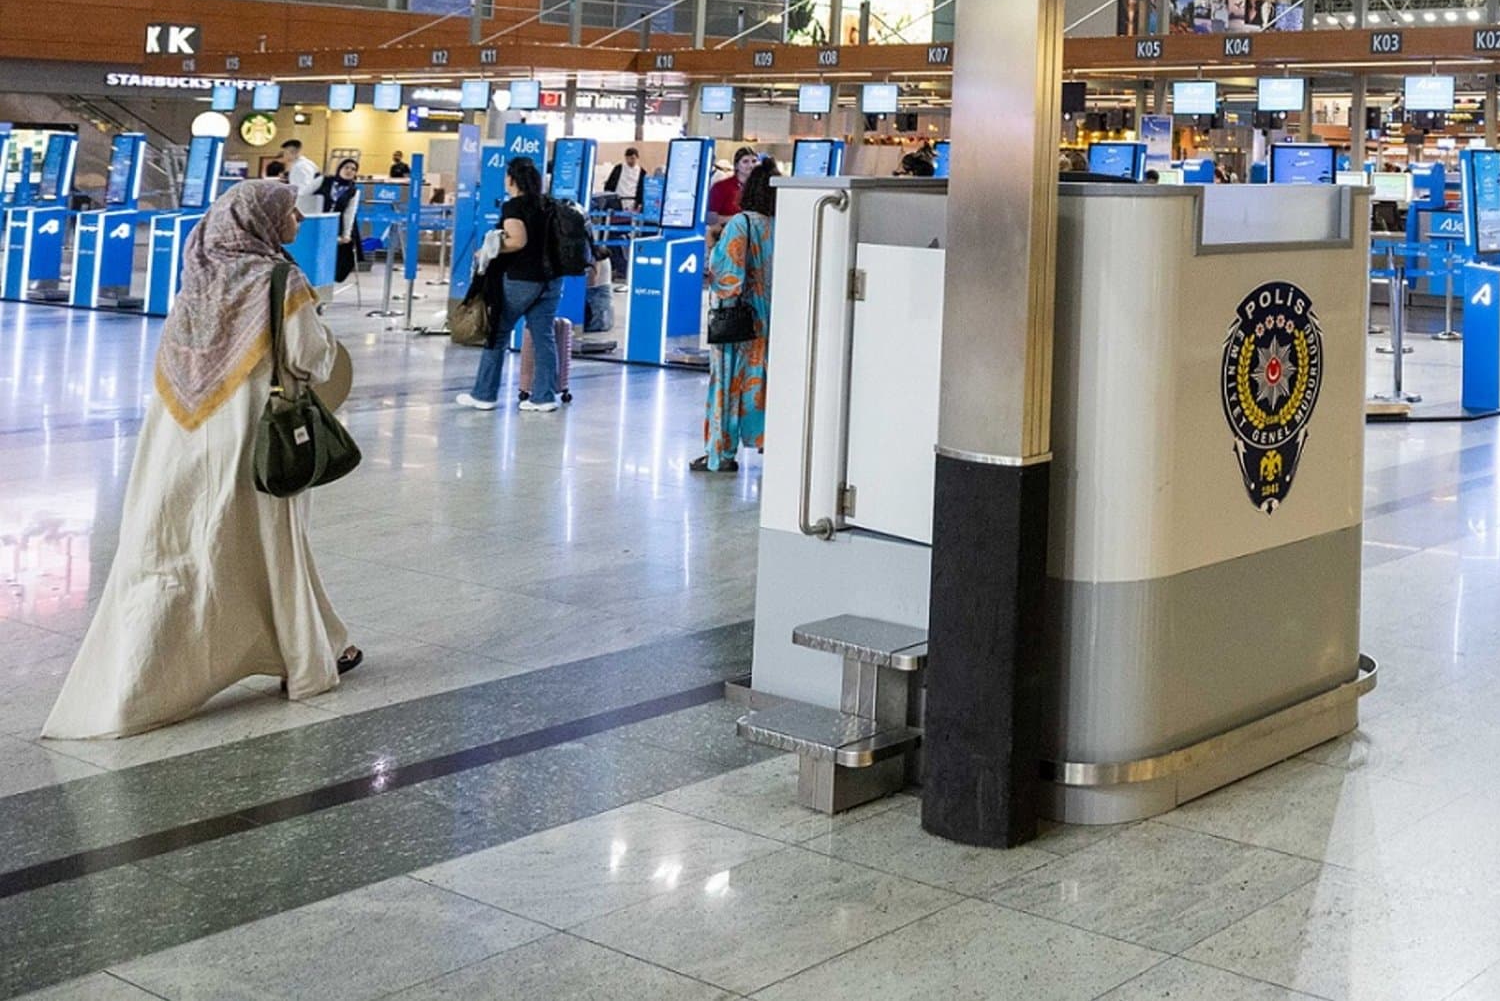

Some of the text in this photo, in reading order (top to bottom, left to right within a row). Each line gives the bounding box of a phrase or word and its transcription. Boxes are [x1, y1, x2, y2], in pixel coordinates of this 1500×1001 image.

[146, 25, 162, 53] K
[168, 25, 196, 54] K
[1224, 38, 1250, 55] K04
[1372, 34, 1400, 52] K03
[819, 50, 837, 65] K08
[928, 47, 949, 63] K07
[1136, 41, 1161, 58] K05
[656, 54, 673, 68] K10
[755, 52, 773, 66] K09
[106, 72, 212, 90] STARBUCKS
[510, 135, 540, 154] AJet
[487, 152, 505, 168] AJ
[1439, 218, 1465, 231] AJe
[1245, 287, 1306, 320] POLİS
[1251, 426, 1291, 444] GENEL
